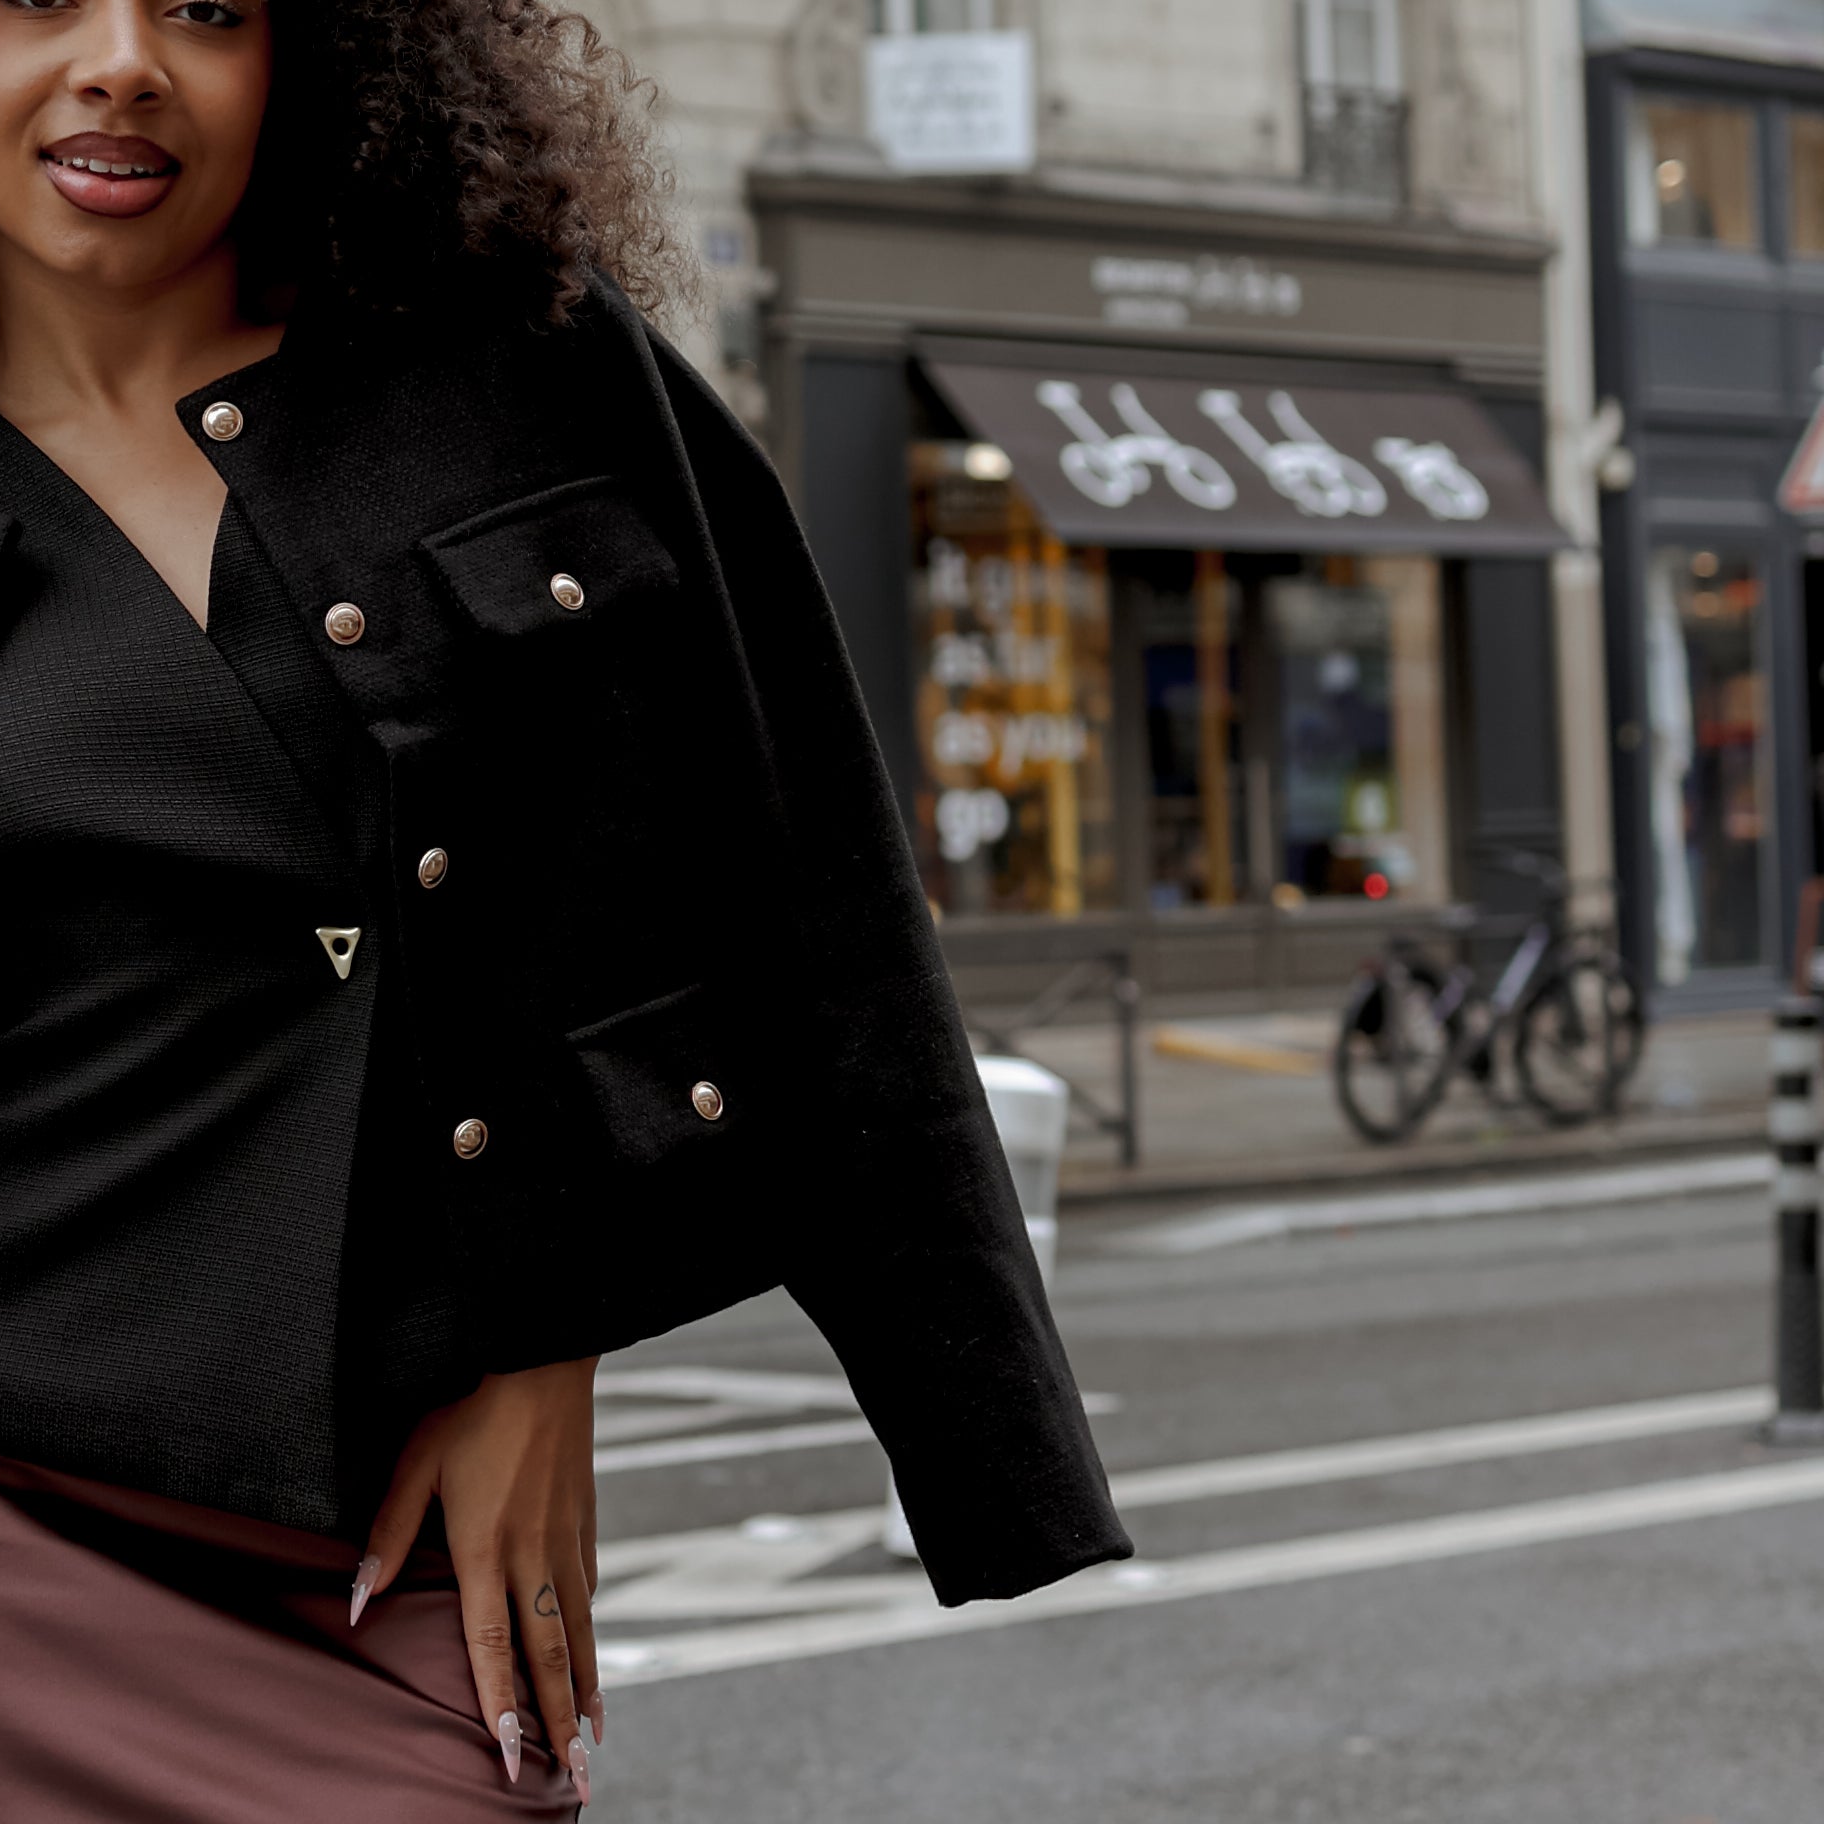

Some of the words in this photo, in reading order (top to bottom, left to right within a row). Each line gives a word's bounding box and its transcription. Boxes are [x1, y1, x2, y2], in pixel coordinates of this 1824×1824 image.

[933, 711, 993, 766] as
[999, 714, 1088, 780] you
[936, 789, 1010, 862] go
